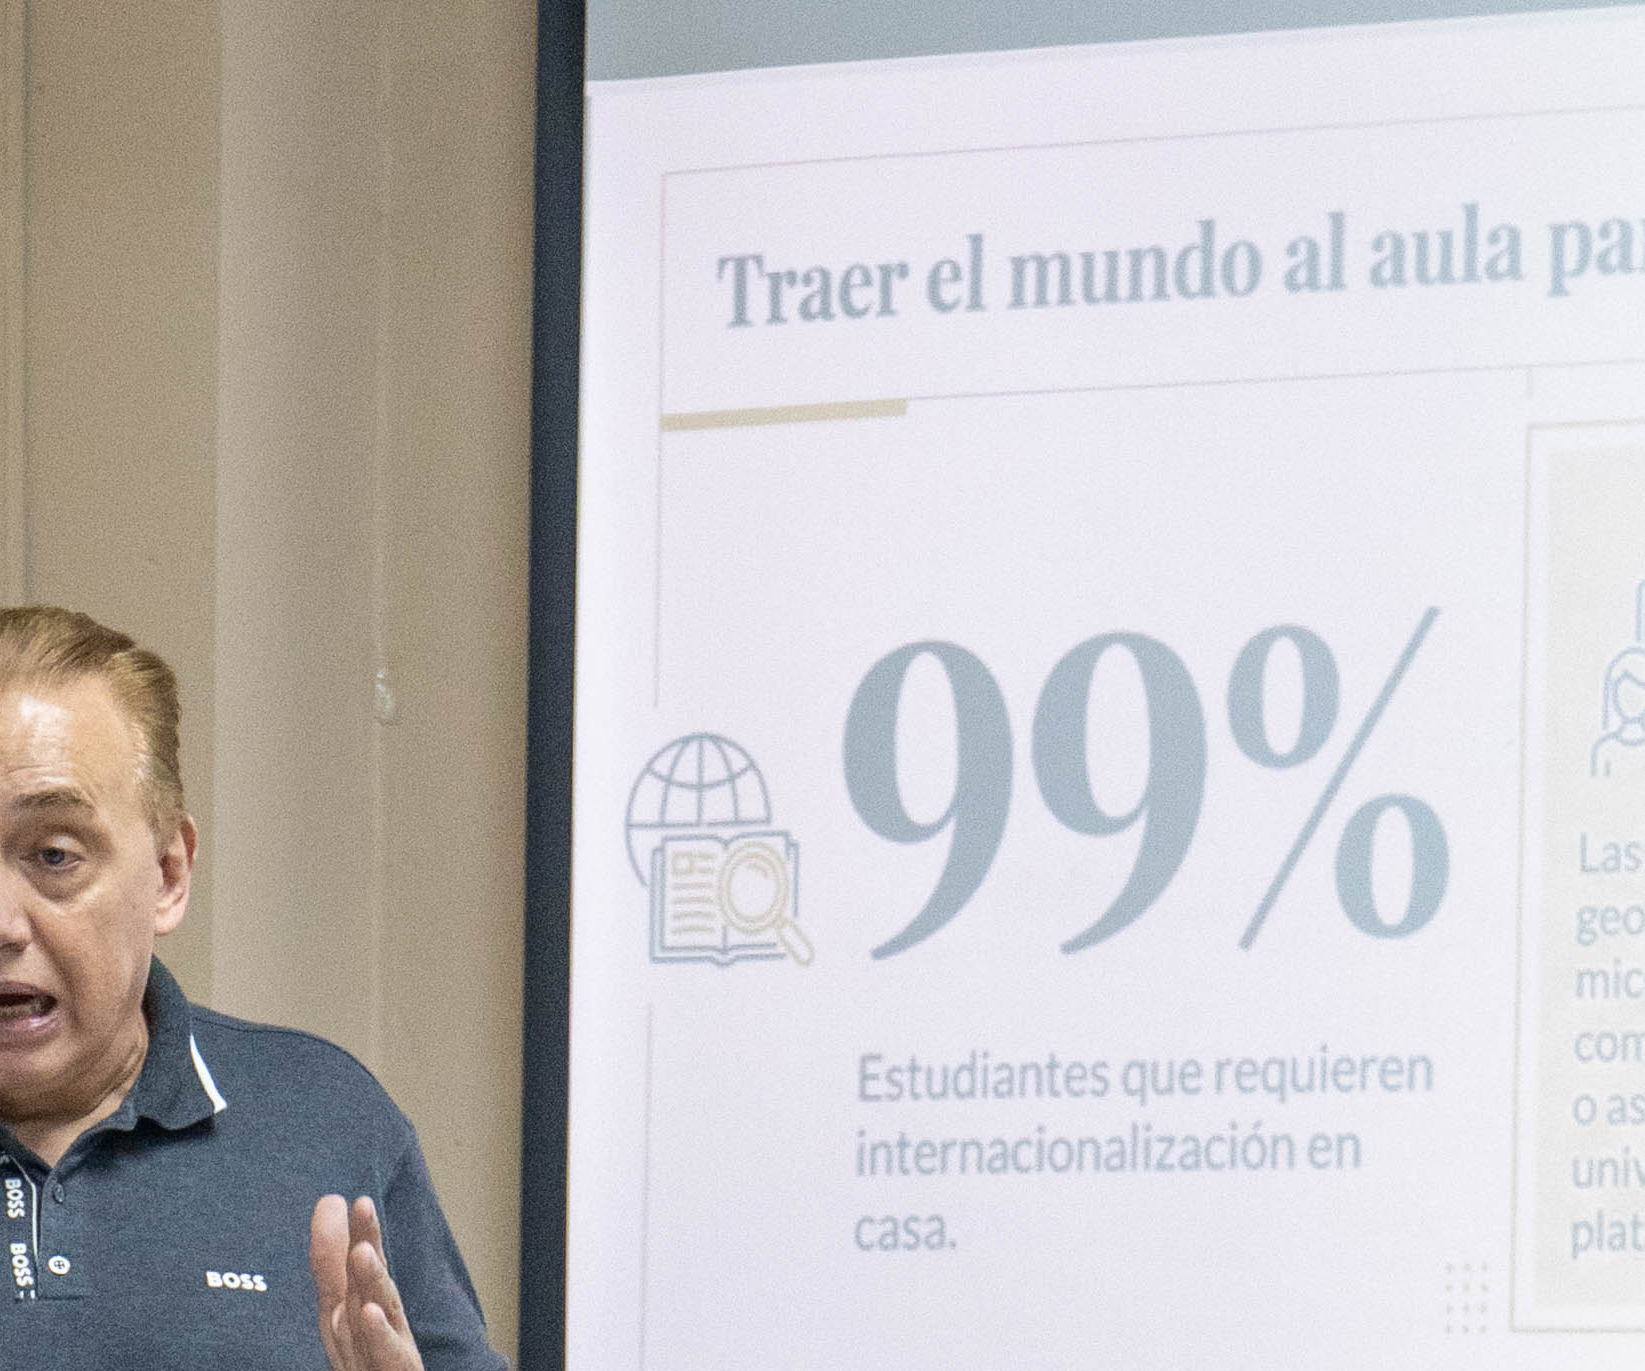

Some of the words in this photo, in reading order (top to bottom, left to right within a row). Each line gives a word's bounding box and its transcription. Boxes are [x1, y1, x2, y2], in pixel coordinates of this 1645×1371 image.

[717, 253, 910, 329] Traer
[926, 233, 987, 314] el
[1007, 218, 1263, 310] mundo
[1283, 210, 1348, 293] al
[1368, 202, 1523, 289] aula
[1547, 217, 1645, 298] pa
[841, 605, 1451, 962] 99%
[1578, 832, 1643, 875] Las
[857, 1050, 1111, 1104] Estudiantes
[1120, 1058, 1204, 1107] que
[1214, 1043, 1434, 1105] requieren
[1571, 1093, 1598, 1128] o
[855, 1120, 1296, 1178] internacionalización
[1306, 1131, 1362, 1172] en
[5, 1177, 26, 1219] BOSS
[853, 1211, 958, 1253] casa.
[9, 1242, 35, 1287] BOSS
[206, 1270, 267, 1292] BOSS
